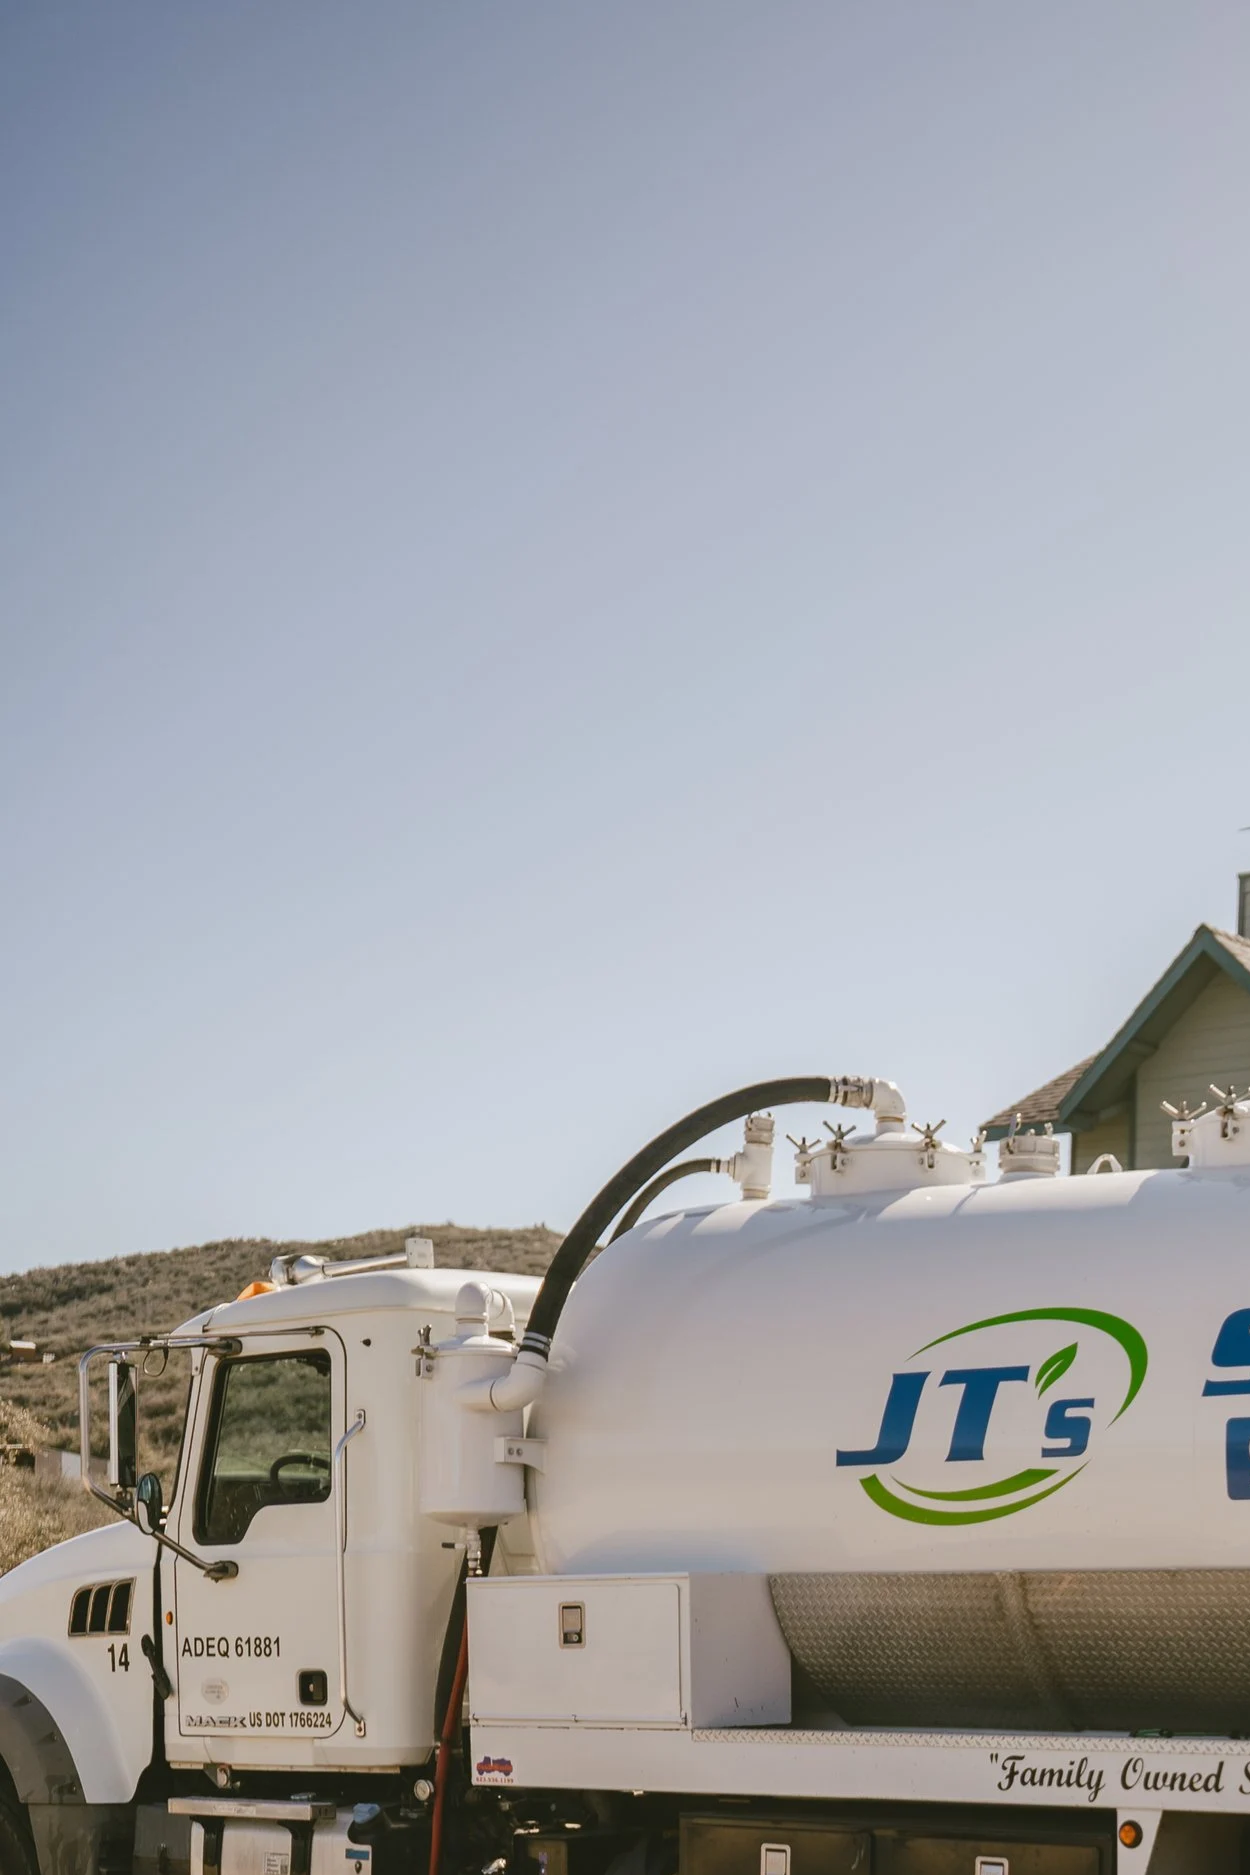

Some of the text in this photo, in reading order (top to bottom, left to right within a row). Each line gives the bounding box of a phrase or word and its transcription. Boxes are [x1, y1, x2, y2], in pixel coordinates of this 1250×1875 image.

[107, 1643, 130, 1673] 14
[181, 1636, 281, 1659] ADEQ 61881
[249, 1711, 332, 1729] US DOT 1766224
[1120, 1757, 1225, 1793] Owned
